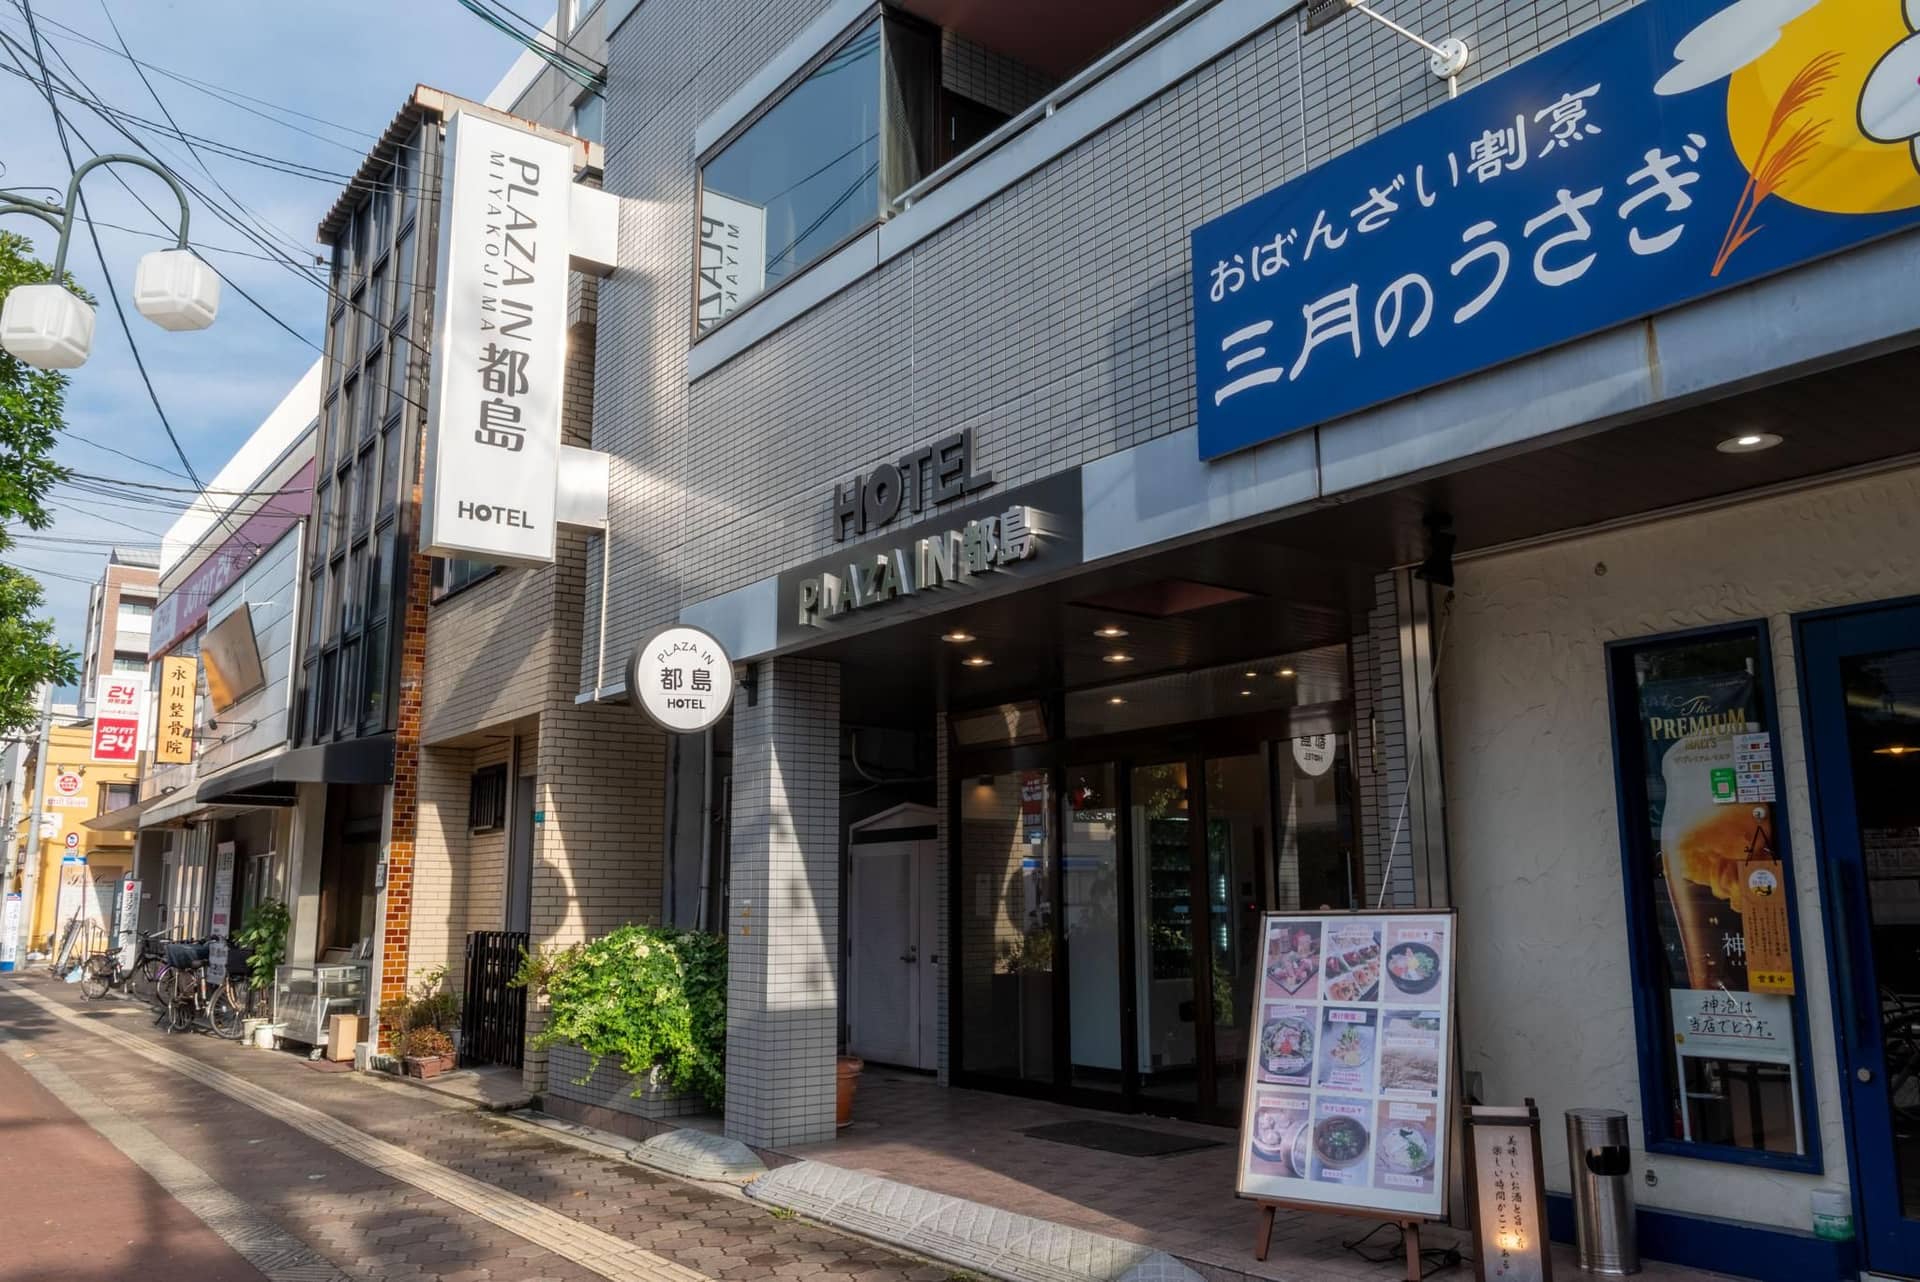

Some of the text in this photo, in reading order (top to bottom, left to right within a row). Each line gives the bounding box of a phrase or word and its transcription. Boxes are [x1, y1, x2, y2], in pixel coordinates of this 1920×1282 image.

[1210, 82, 1602, 302] おばんざい割烹
[480, 150, 506, 332] MIYAKOJIMA
[500, 157, 540, 342] PLAZA IN
[1214, 133, 1707, 406] 三月のうさぎ
[474, 342, 530, 453] 都島
[458, 500, 535, 530] HOTEL
[832, 425, 998, 542] HOTEL
[798, 547, 915, 625] PLAZA
[107, 685, 135, 699] 24
[657, 642, 715, 665] PLAZA IN
[660, 666, 712, 692] 都島
[97, 734, 134, 752] 24
[165, 665, 187, 755] 永川整骨院
[667, 698, 706, 710] HOTEL
[1649, 707, 1748, 740] PREMIUM
